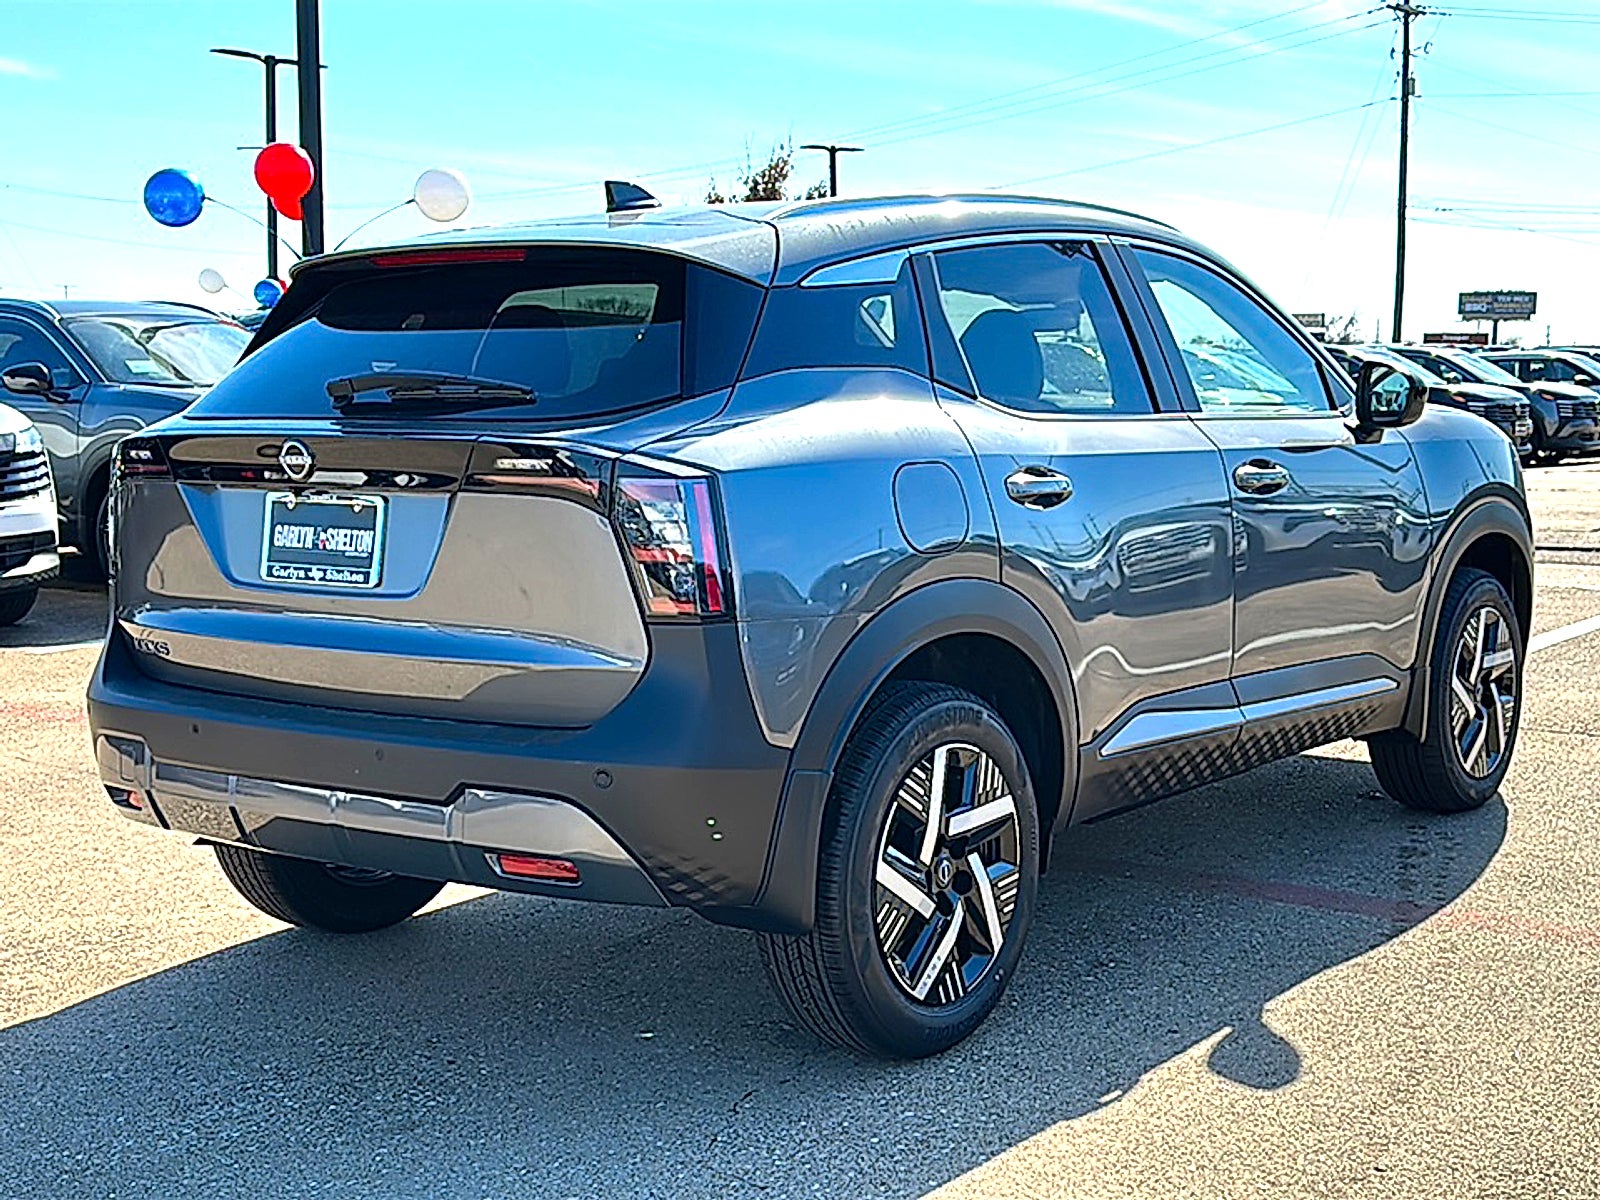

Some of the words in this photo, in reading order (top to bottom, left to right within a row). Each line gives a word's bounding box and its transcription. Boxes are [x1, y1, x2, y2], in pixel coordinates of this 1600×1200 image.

[273, 524, 315, 549] GARLYN
[326, 527, 375, 553] SHELTON
[272, 566, 306, 580] Garlyn
[325, 569, 365, 582] Shelton
